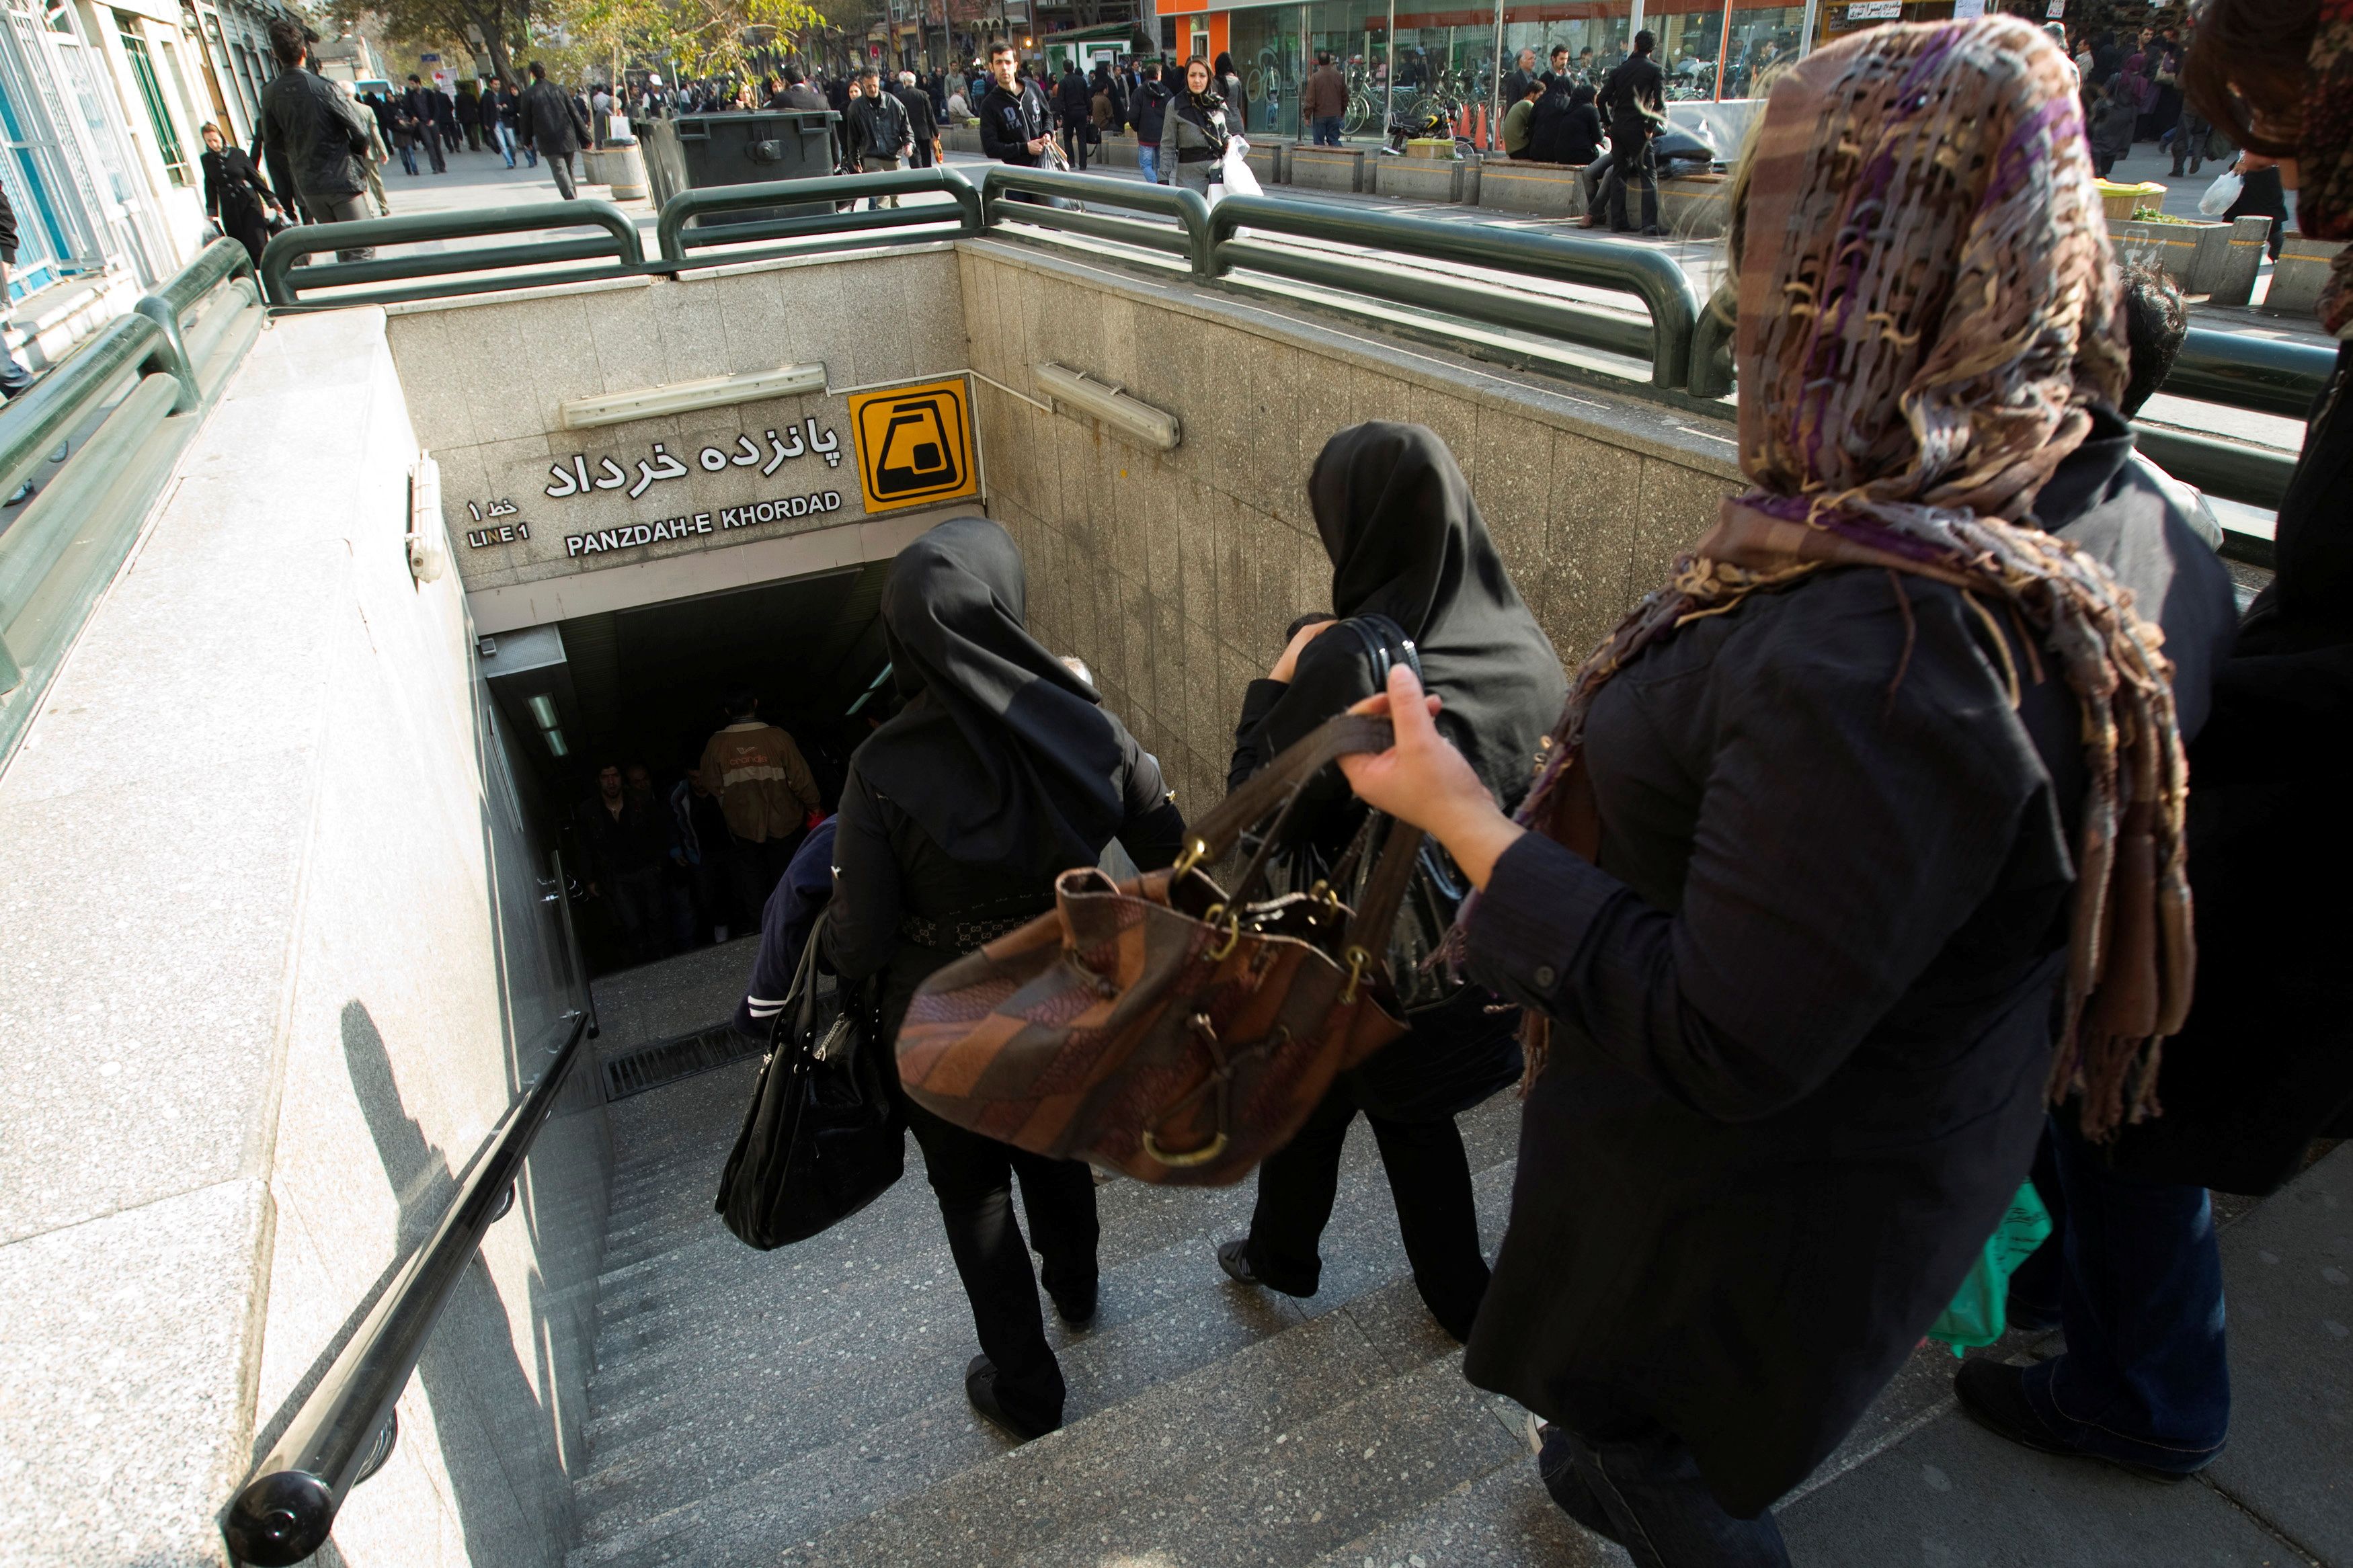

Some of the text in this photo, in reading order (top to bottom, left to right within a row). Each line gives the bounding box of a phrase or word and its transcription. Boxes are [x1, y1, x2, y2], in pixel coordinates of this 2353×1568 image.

[1866, 2, 1882, 16] پیتزا
[544, 417, 840, 499] پانزده خرداد
[467, 499, 518, 522] خط ۱
[567, 491, 841, 556] PANZDAH-E KHORDAD
[468, 522, 529, 548] LINE 1
